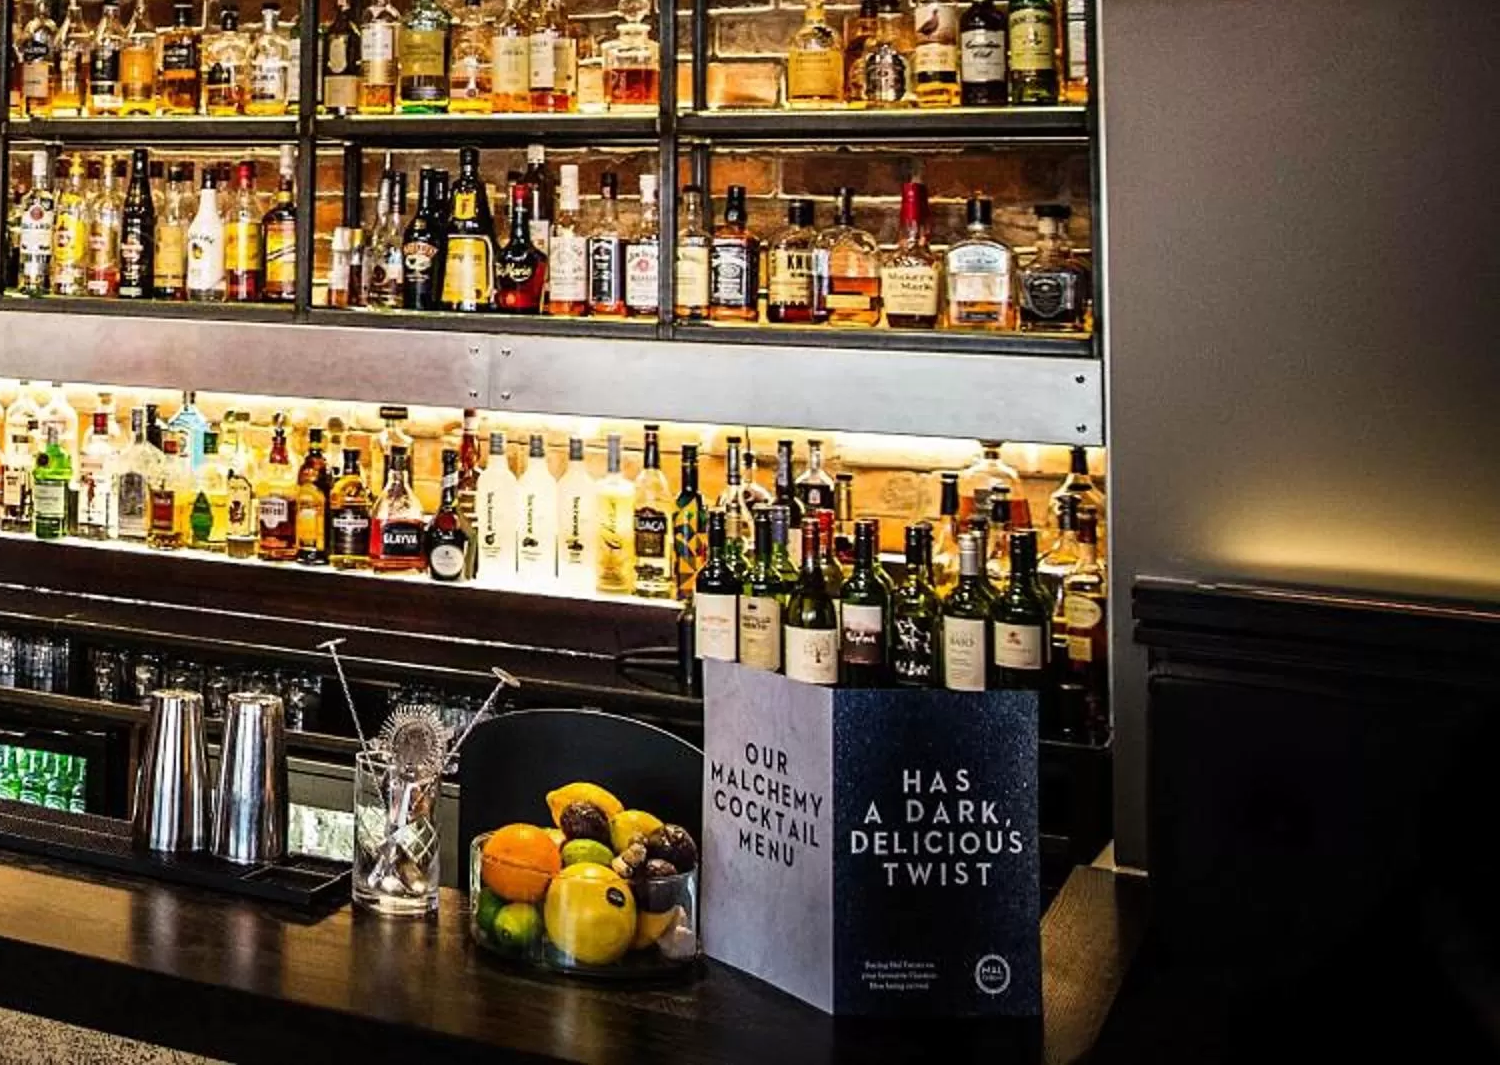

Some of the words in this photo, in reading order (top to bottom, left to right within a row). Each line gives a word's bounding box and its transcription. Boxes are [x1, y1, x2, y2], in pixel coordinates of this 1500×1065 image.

[744, 742, 789, 776] OUR
[710, 761, 824, 819] MALCHEMY
[902, 768, 970, 793] HAS
[714, 791, 821, 849] COCKTAIL
[863, 801, 883, 825] A
[905, 799, 1013, 828] DARK,
[738, 829, 796, 868] MENU
[850, 831, 1024, 855] DELICIOUS
[883, 862, 993, 886] TWIST
